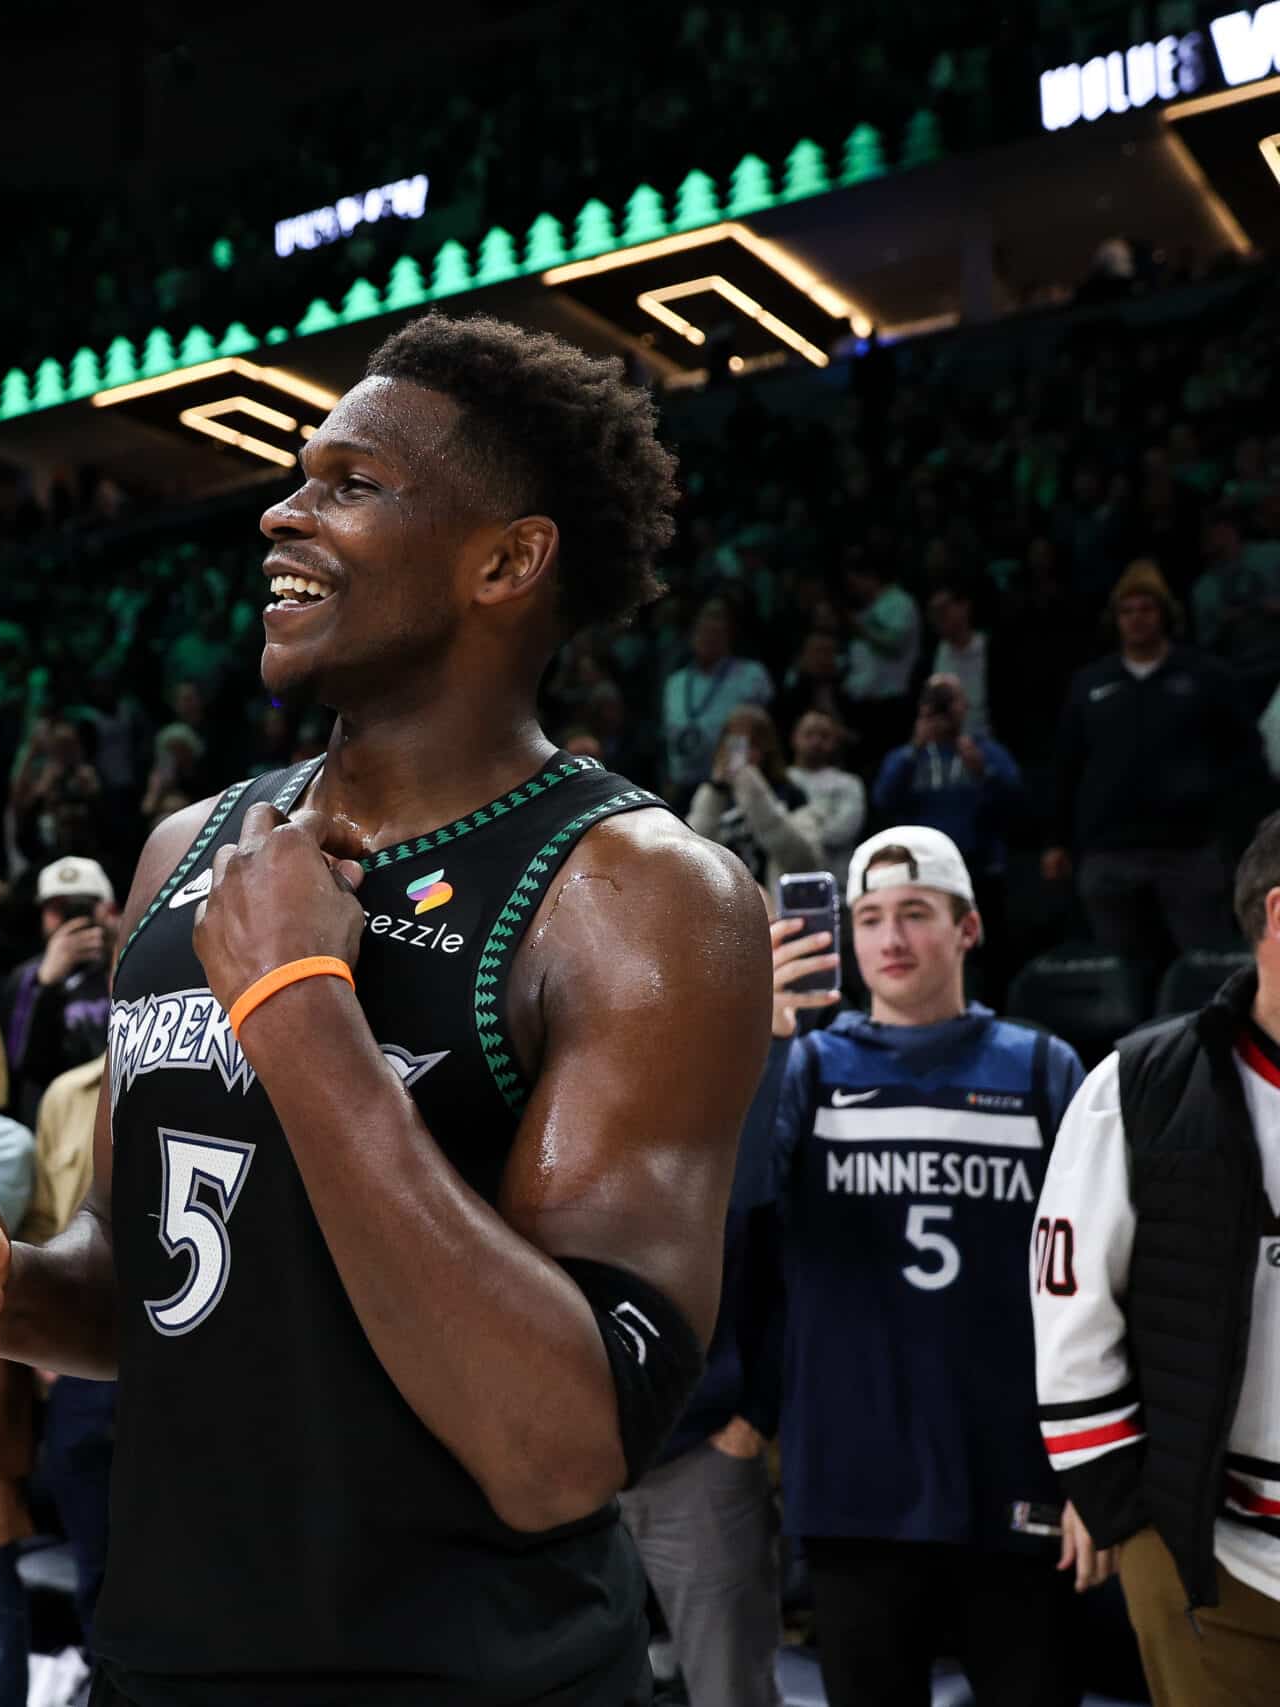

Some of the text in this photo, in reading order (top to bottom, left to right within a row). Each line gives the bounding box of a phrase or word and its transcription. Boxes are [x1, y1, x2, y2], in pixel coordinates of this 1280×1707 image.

[826, 1151, 1036, 1202] MINNESOTA
[144, 1126, 256, 1337] 5
[902, 1204, 961, 1291] 5
